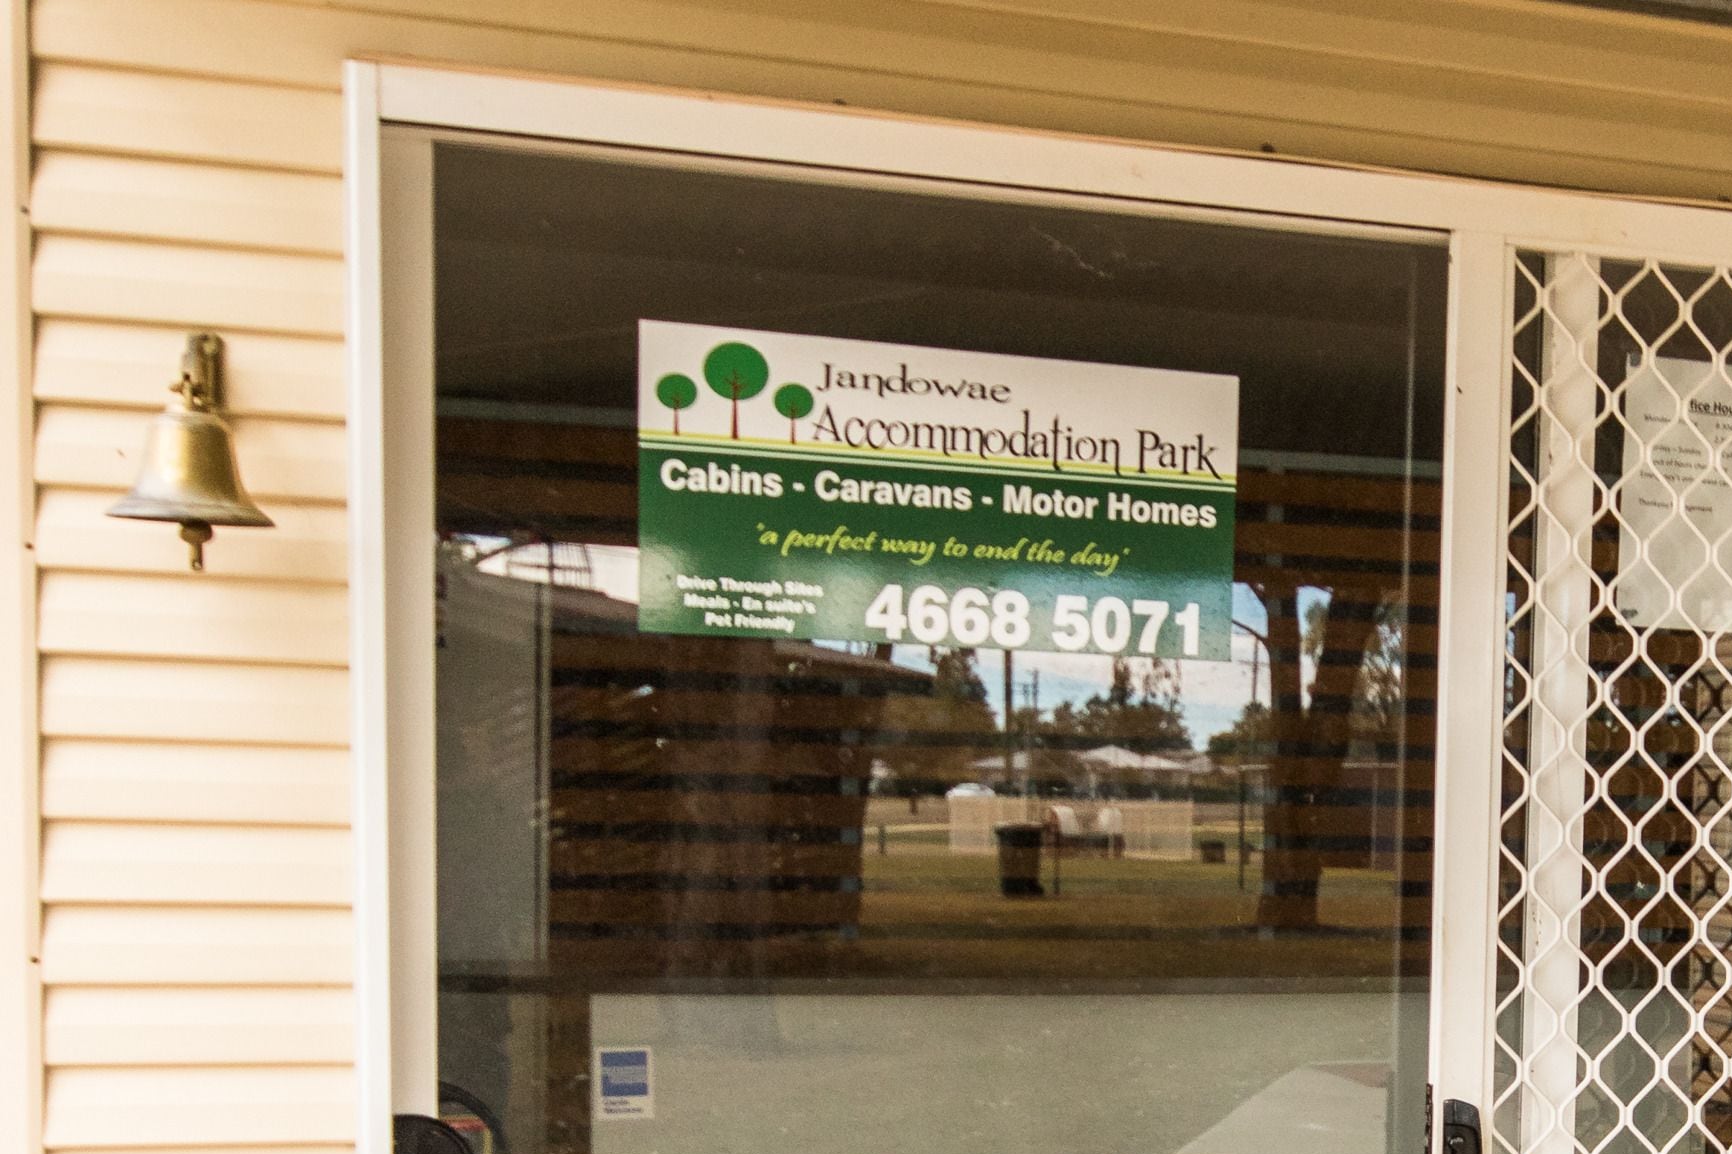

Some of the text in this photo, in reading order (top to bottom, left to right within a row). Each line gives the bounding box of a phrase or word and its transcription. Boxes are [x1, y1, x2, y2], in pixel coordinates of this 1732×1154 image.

[817, 362, 1012, 404] Jandowae
[811, 403, 1223, 481] Accommodation Park
[660, 458, 1218, 529] Cabins - Caravans - Motor Homes
[780, 525, 878, 557] perfect
[881, 538, 937, 566] way
[942, 536, 969, 557] to
[973, 536, 1030, 561] end
[1026, 538, 1066, 565] the
[719, 577, 783, 597] Through
[734, 613, 796, 634] Friendly
[864, 582, 1200, 656] 4668 5071
